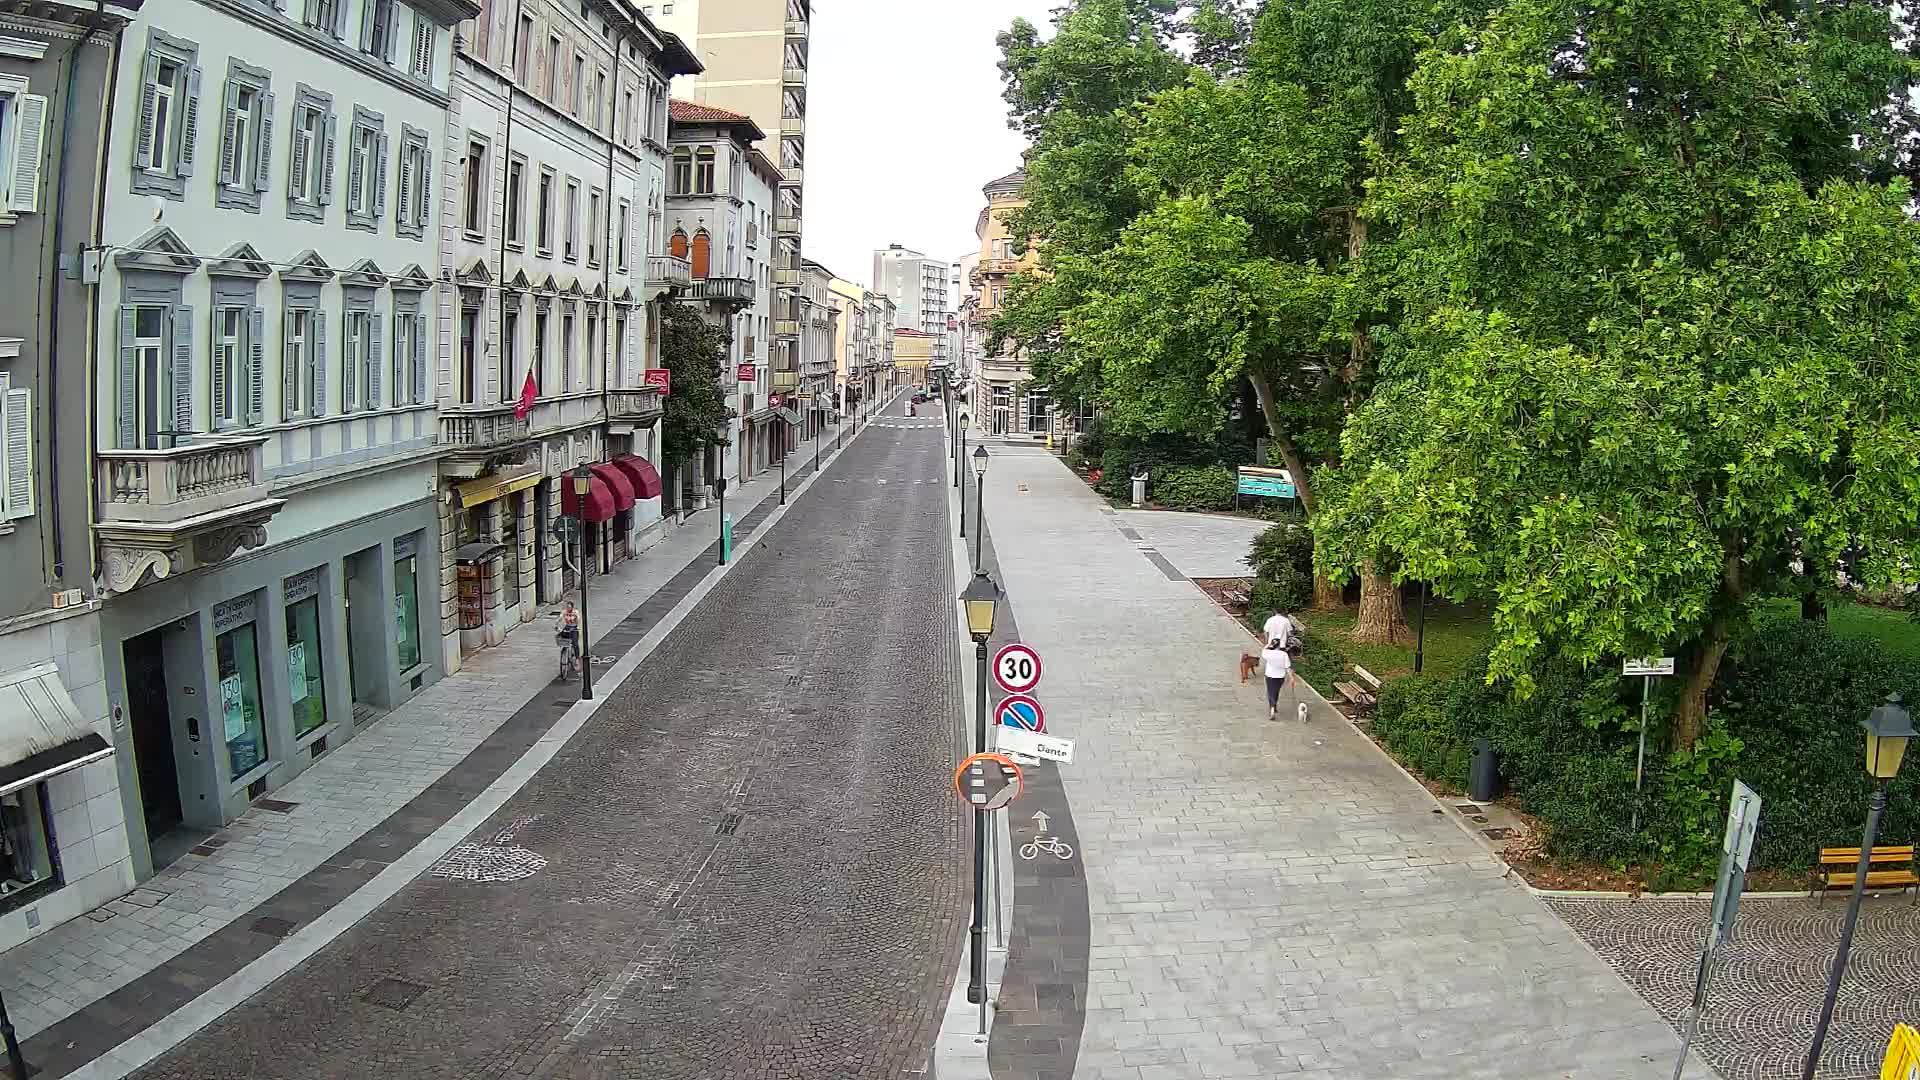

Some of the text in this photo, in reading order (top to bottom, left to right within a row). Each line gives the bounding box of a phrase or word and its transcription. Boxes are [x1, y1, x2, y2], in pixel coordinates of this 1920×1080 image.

[215, 613, 243, 629] OPERATIVO
[1005, 658, 1032, 680] 30
[221, 677, 239, 700] 130
[1037, 743, 1067, 757] Dante
